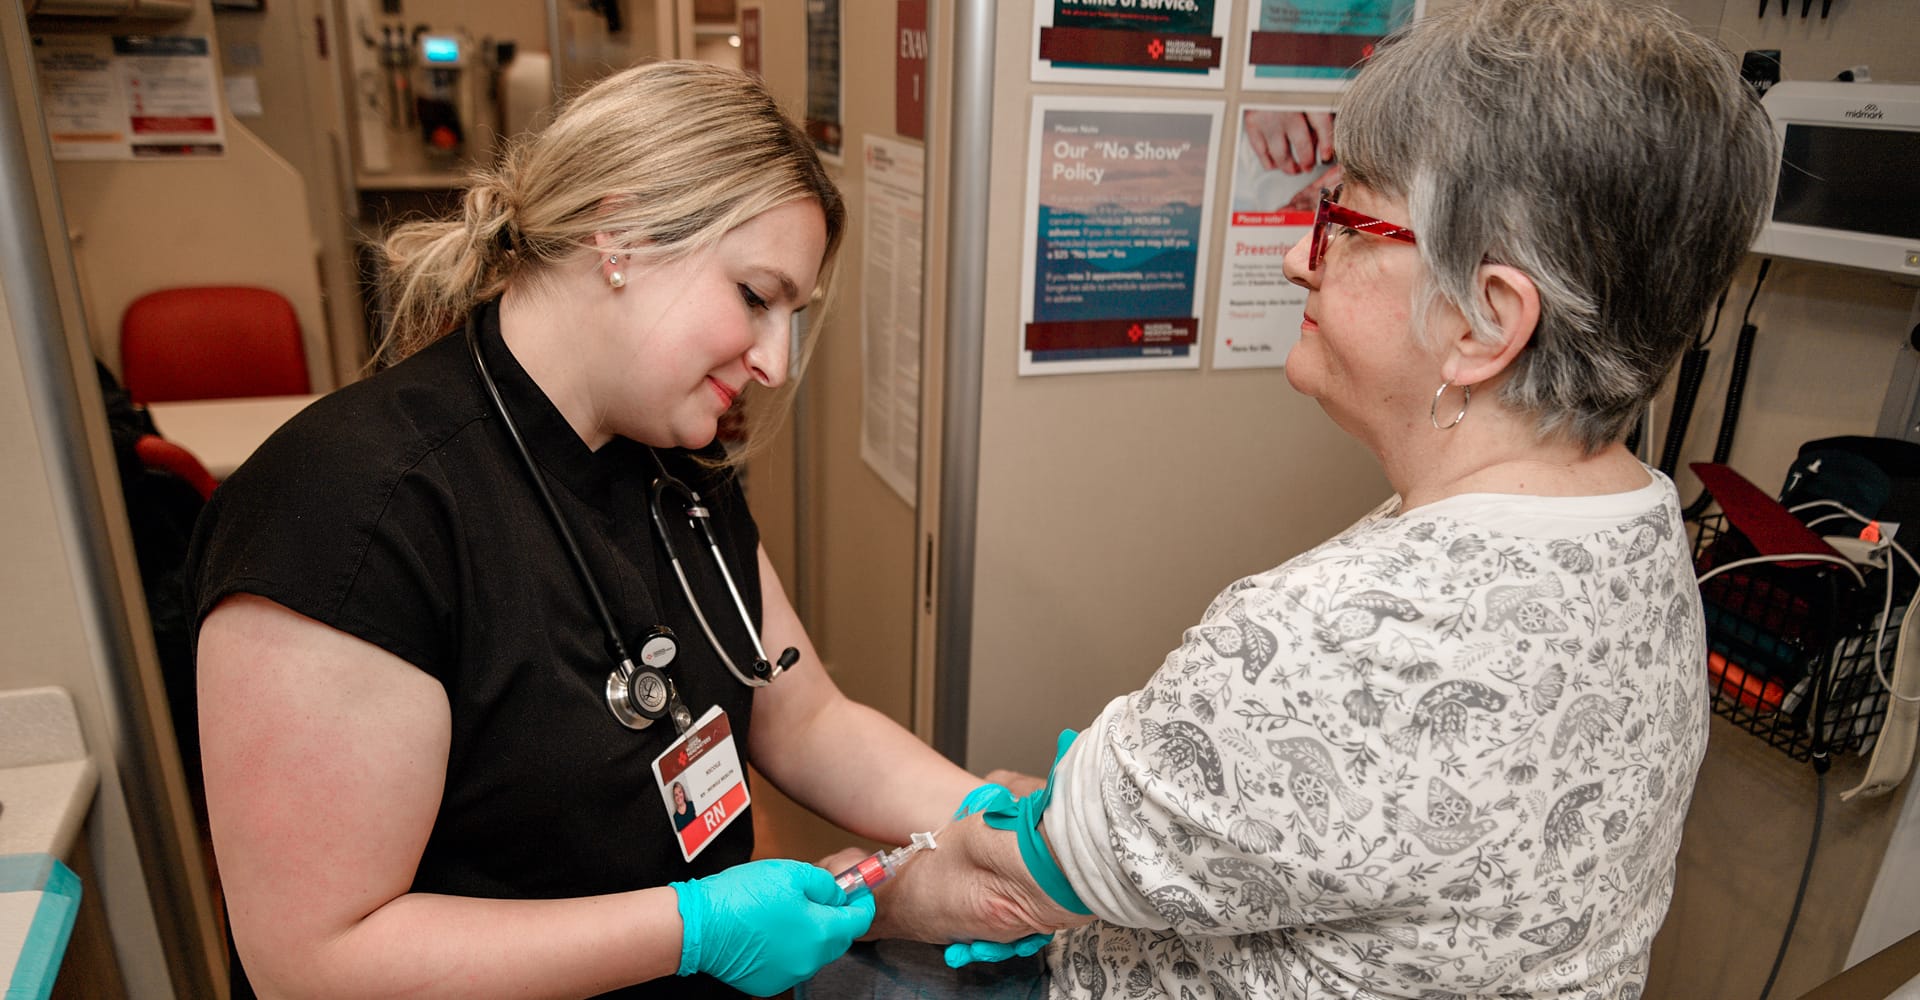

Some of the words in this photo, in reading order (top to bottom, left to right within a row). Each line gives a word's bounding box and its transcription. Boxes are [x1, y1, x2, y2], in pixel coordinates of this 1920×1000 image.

[1140, 0, 1198, 12] service.
[1845, 110, 1884, 120] midmark
[1054, 141, 1088, 159] Our
[1134, 141, 1191, 160] Show"
[1052, 162, 1104, 186] Policy
[704, 801, 726, 832] RN
